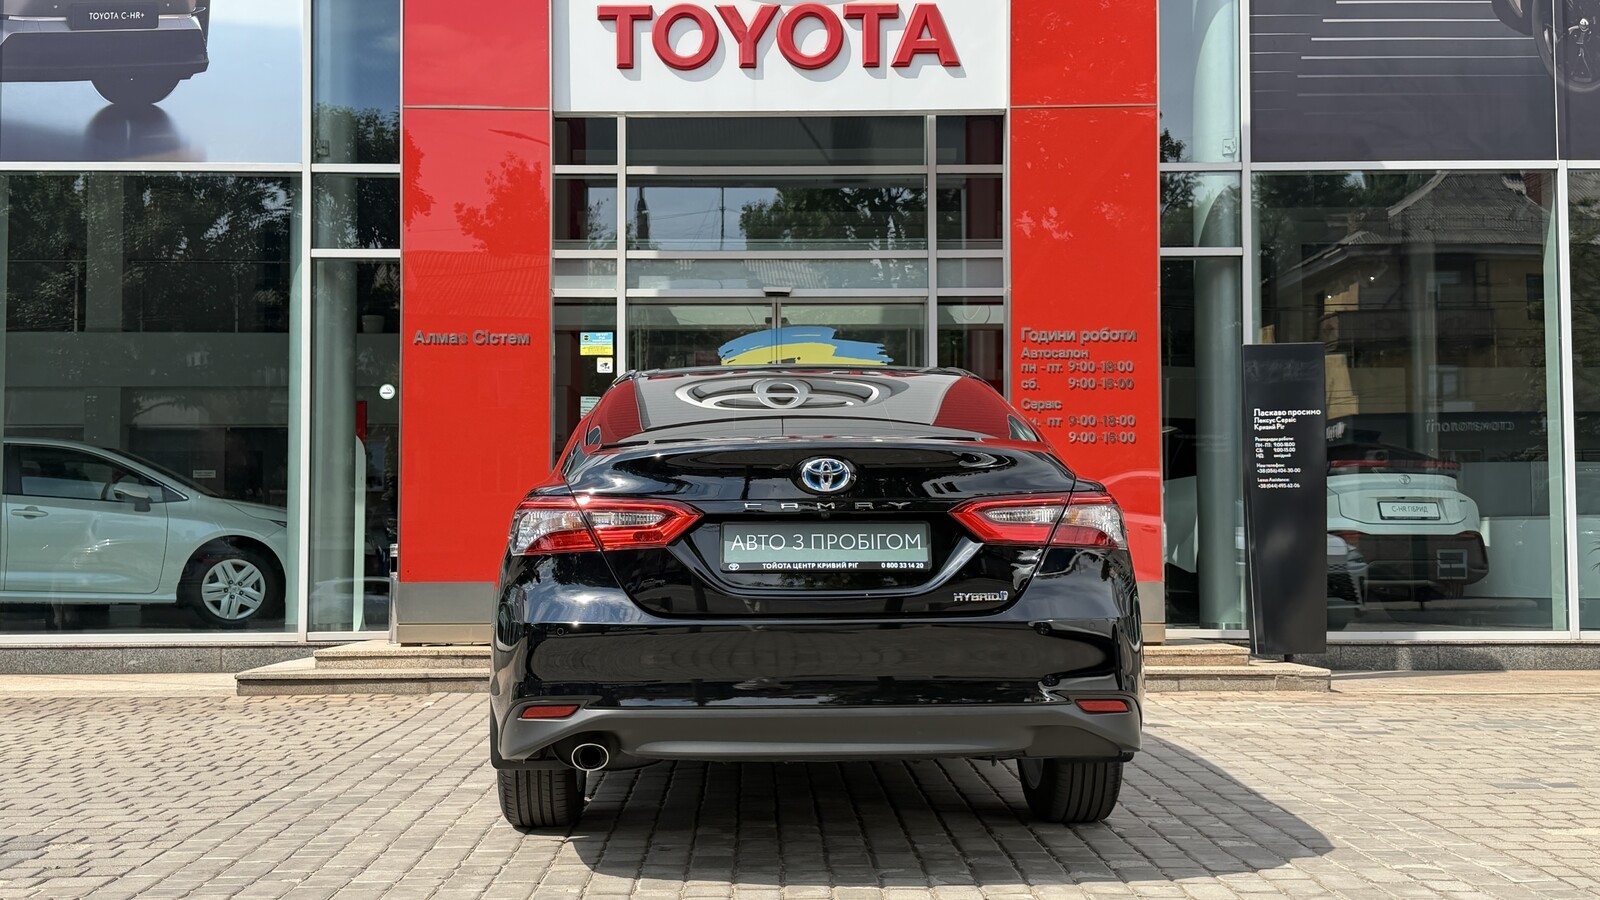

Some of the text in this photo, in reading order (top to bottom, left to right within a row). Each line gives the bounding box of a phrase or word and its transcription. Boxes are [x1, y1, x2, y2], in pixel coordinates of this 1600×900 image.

[89, 12, 119, 20] TOYOTA
[597, 2, 961, 70] TOYOTA
[413, 329, 530, 345] Алмаз Сістем
[1021, 327, 1137, 345] Години роботи
[1021, 347, 1089, 359] Автосалон
[1068, 360, 1134, 373] 9:00-18:00
[1021, 377, 1040, 390] сб.
[1021, 398, 1063, 413] Сервіс
[1253, 408, 1322, 417] Ласкаво просимо
[1068, 415, 1136, 427] 9:00-18:00
[744, 501, 911, 510] CAMRY
[730, 533, 921, 551] АВТО З ПРОБІГОМ
[953, 592, 1000, 602] HYBRID
